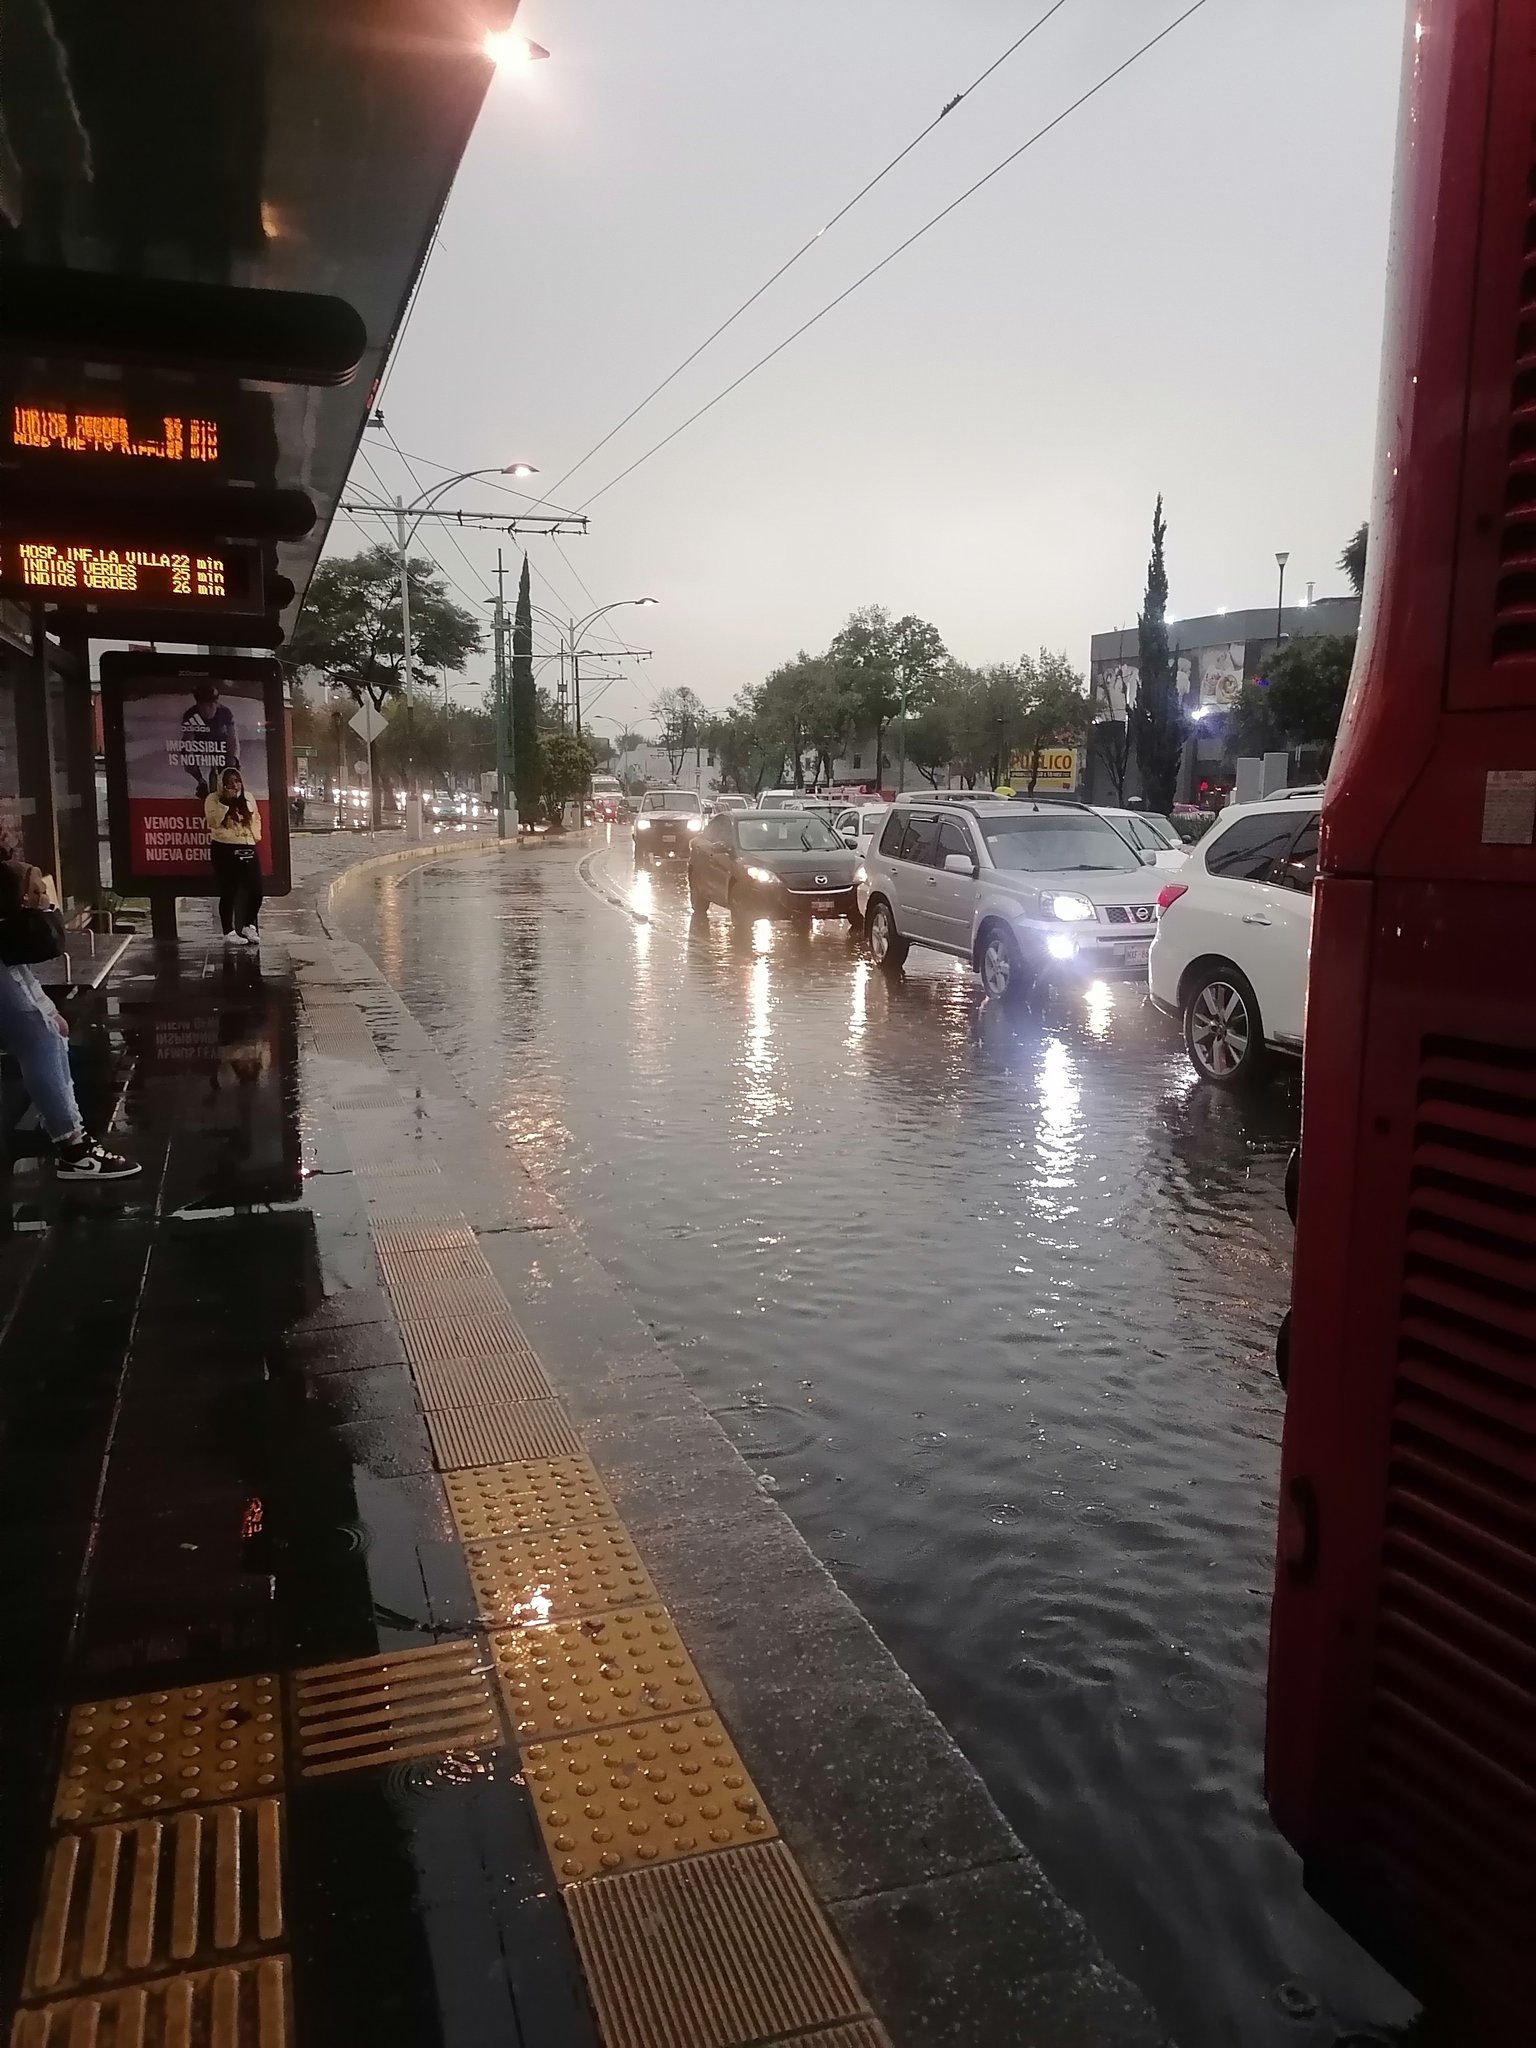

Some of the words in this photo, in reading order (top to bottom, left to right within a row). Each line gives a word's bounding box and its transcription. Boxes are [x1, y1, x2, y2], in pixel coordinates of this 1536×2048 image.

[196, 556, 224, 571] min
[24, 558, 76, 574] INDIOS
[83, 562, 137, 577] VERDES
[172, 568, 190, 580] 25
[197, 569, 225, 583] min
[25, 571, 77, 587] INDIOS
[83, 575, 137, 590] VERDES
[173, 580, 192, 594] 26
[198, 582, 226, 596] min
[166, 740, 227, 753] IMPOSSIBLE
[169, 754, 179, 766] IS
[180, 754, 226, 767] NOTHING
[144, 816, 184, 829] VEMOS
[146, 848, 183, 861] NUEVA
